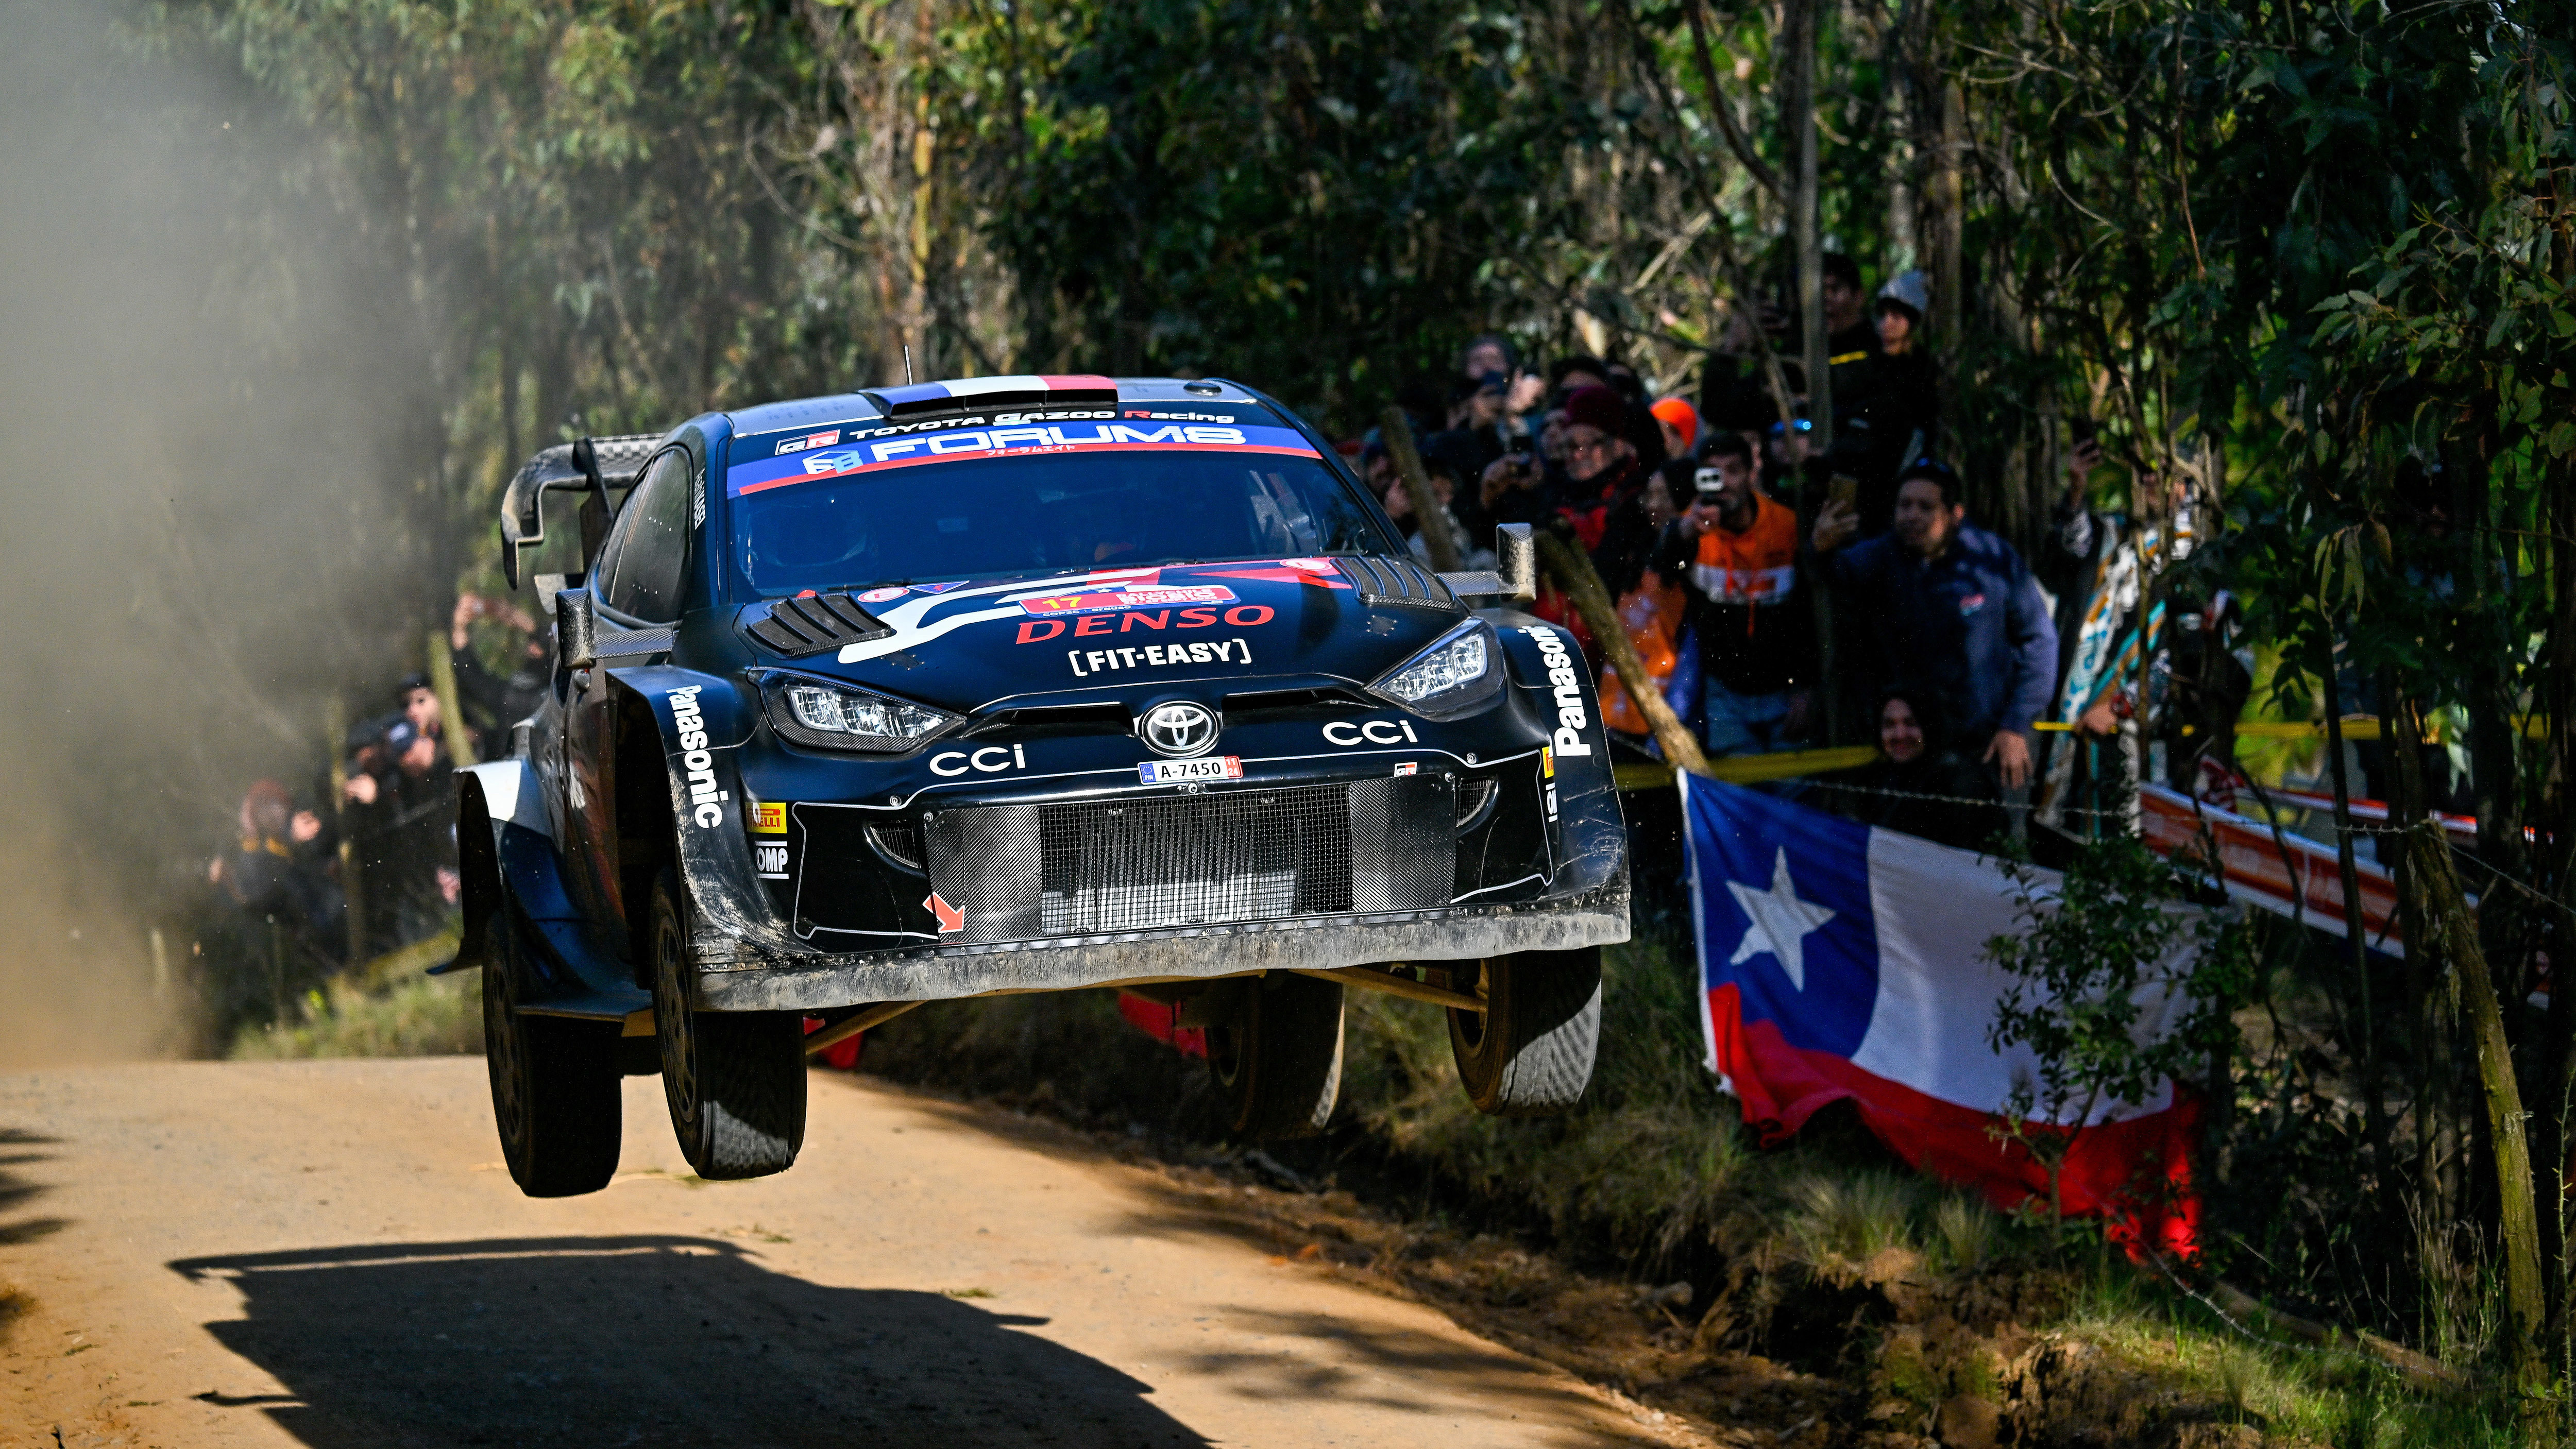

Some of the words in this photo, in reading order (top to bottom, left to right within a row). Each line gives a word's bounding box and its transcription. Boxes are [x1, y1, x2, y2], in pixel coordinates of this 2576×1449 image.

[849, 416, 986, 439] TOYOTA
[992, 410, 1116, 426] GAZOO
[1124, 410, 1235, 424] Racing
[871, 424, 1246, 463] FORUM8
[985, 444, 1076, 456] フォーラムエイト
[1042, 596, 1082, 609] 17
[1015, 605, 1275, 644] DENSO
[666, 685, 729, 829] Panasonic
[1226, 758, 1235, 766] 11
[1161, 762, 1221, 778] A-7450
[1228, 768, 1238, 776] 24
[756, 848, 788, 872] OMP
